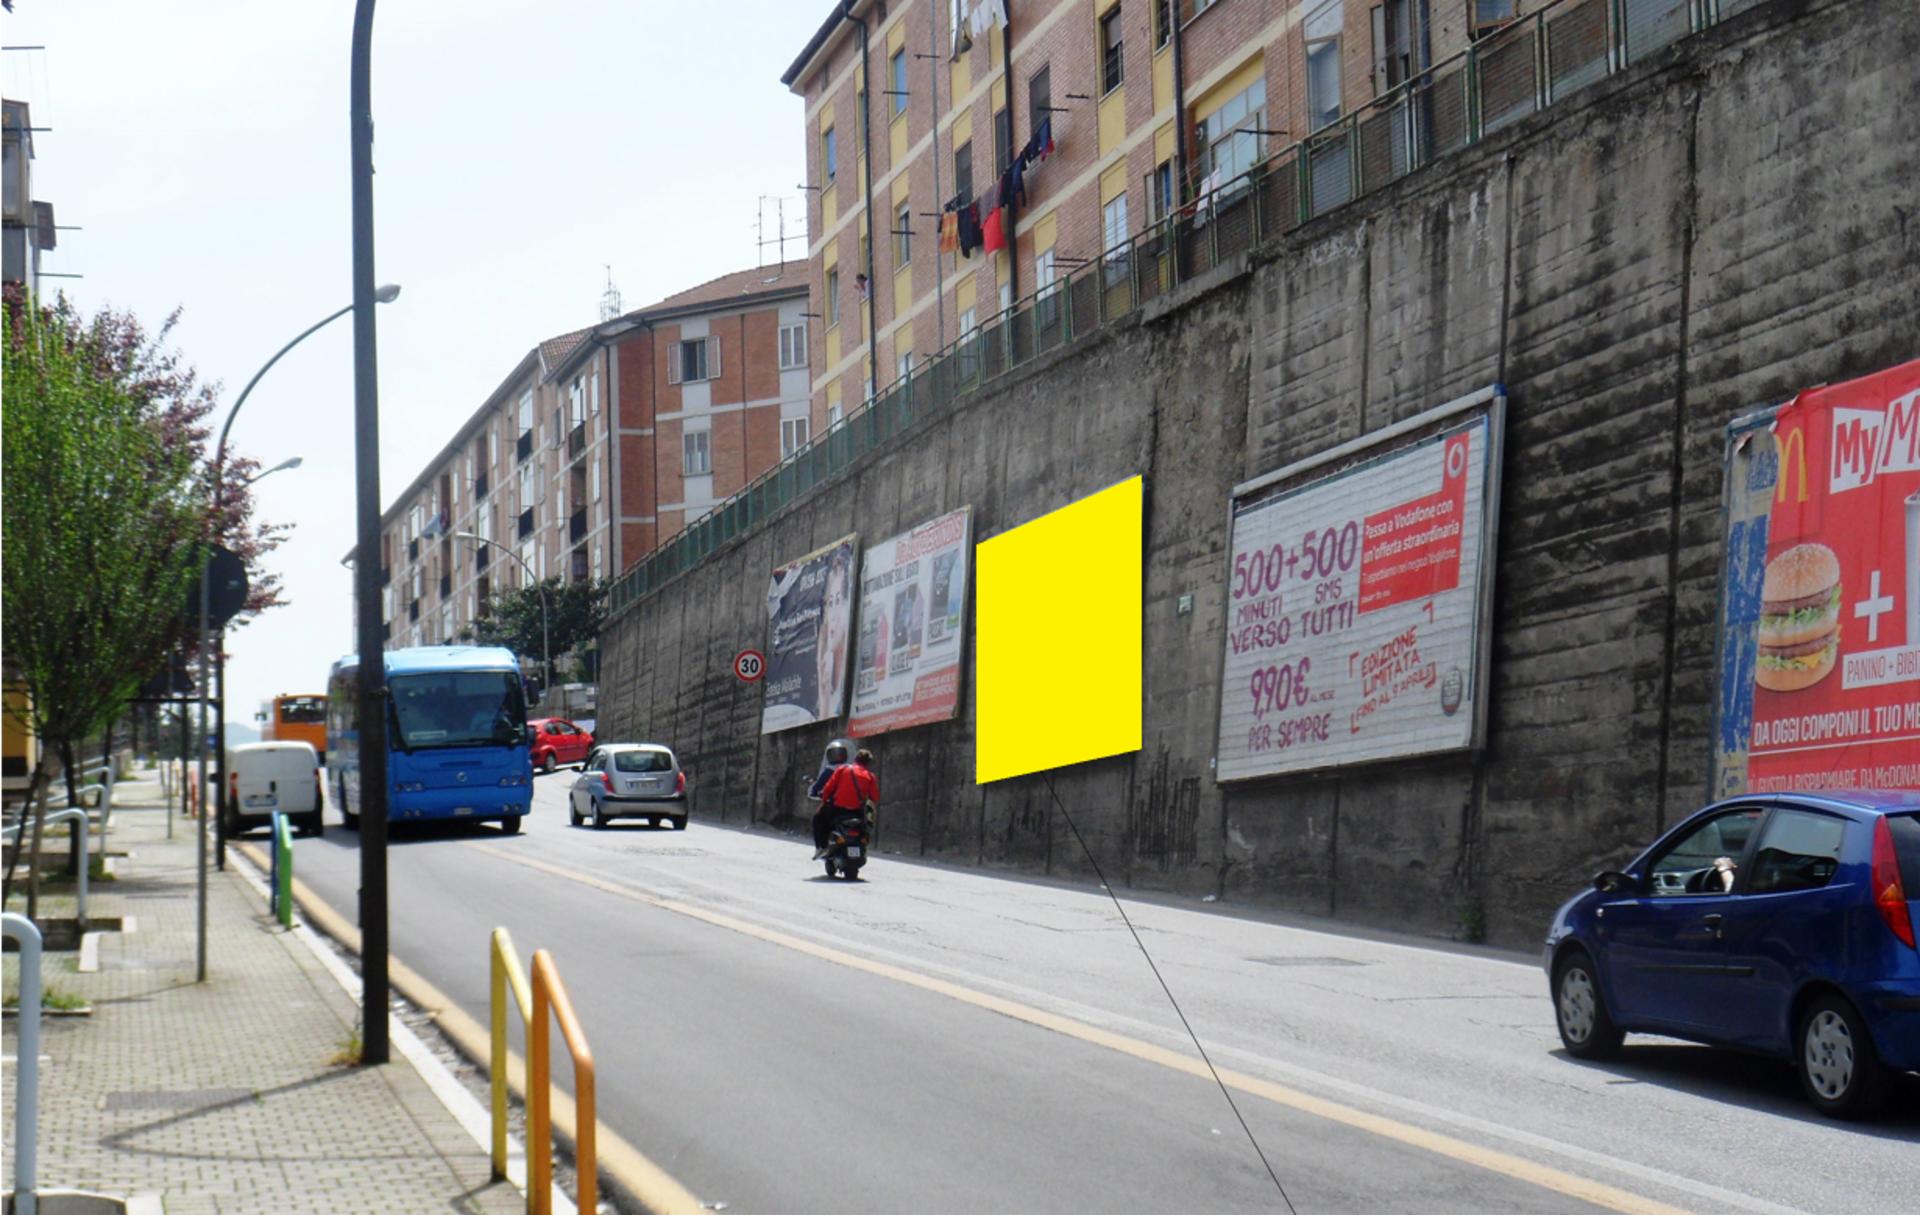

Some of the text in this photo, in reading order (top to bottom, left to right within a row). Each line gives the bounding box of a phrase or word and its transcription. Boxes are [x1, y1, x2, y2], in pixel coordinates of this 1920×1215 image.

[1395, 506, 1435, 530] Vodafone
[1437, 499, 1454, 515] con
[1403, 520, 1460, 551] straordinaria
[1237, 595, 1283, 625] MINUTI
[1315, 577, 1342, 605] SMS
[1231, 600, 1354, 655] VERSO TUTTI
[741, 658, 759, 673] 30
[1361, 624, 1419, 678] EDIZIONE
[1846, 655, 1886, 683] PANINO
[1363, 648, 1422, 698] LIMITATA
[1248, 712, 1332, 753] PER SEMPRE
[1754, 722, 1770, 746] DA
[1772, 717, 1799, 744] OGGI
[1801, 708, 1859, 741] COMPONI
[1861, 707, 1871, 734] IL
[1874, 704, 1901, 733] TUO
